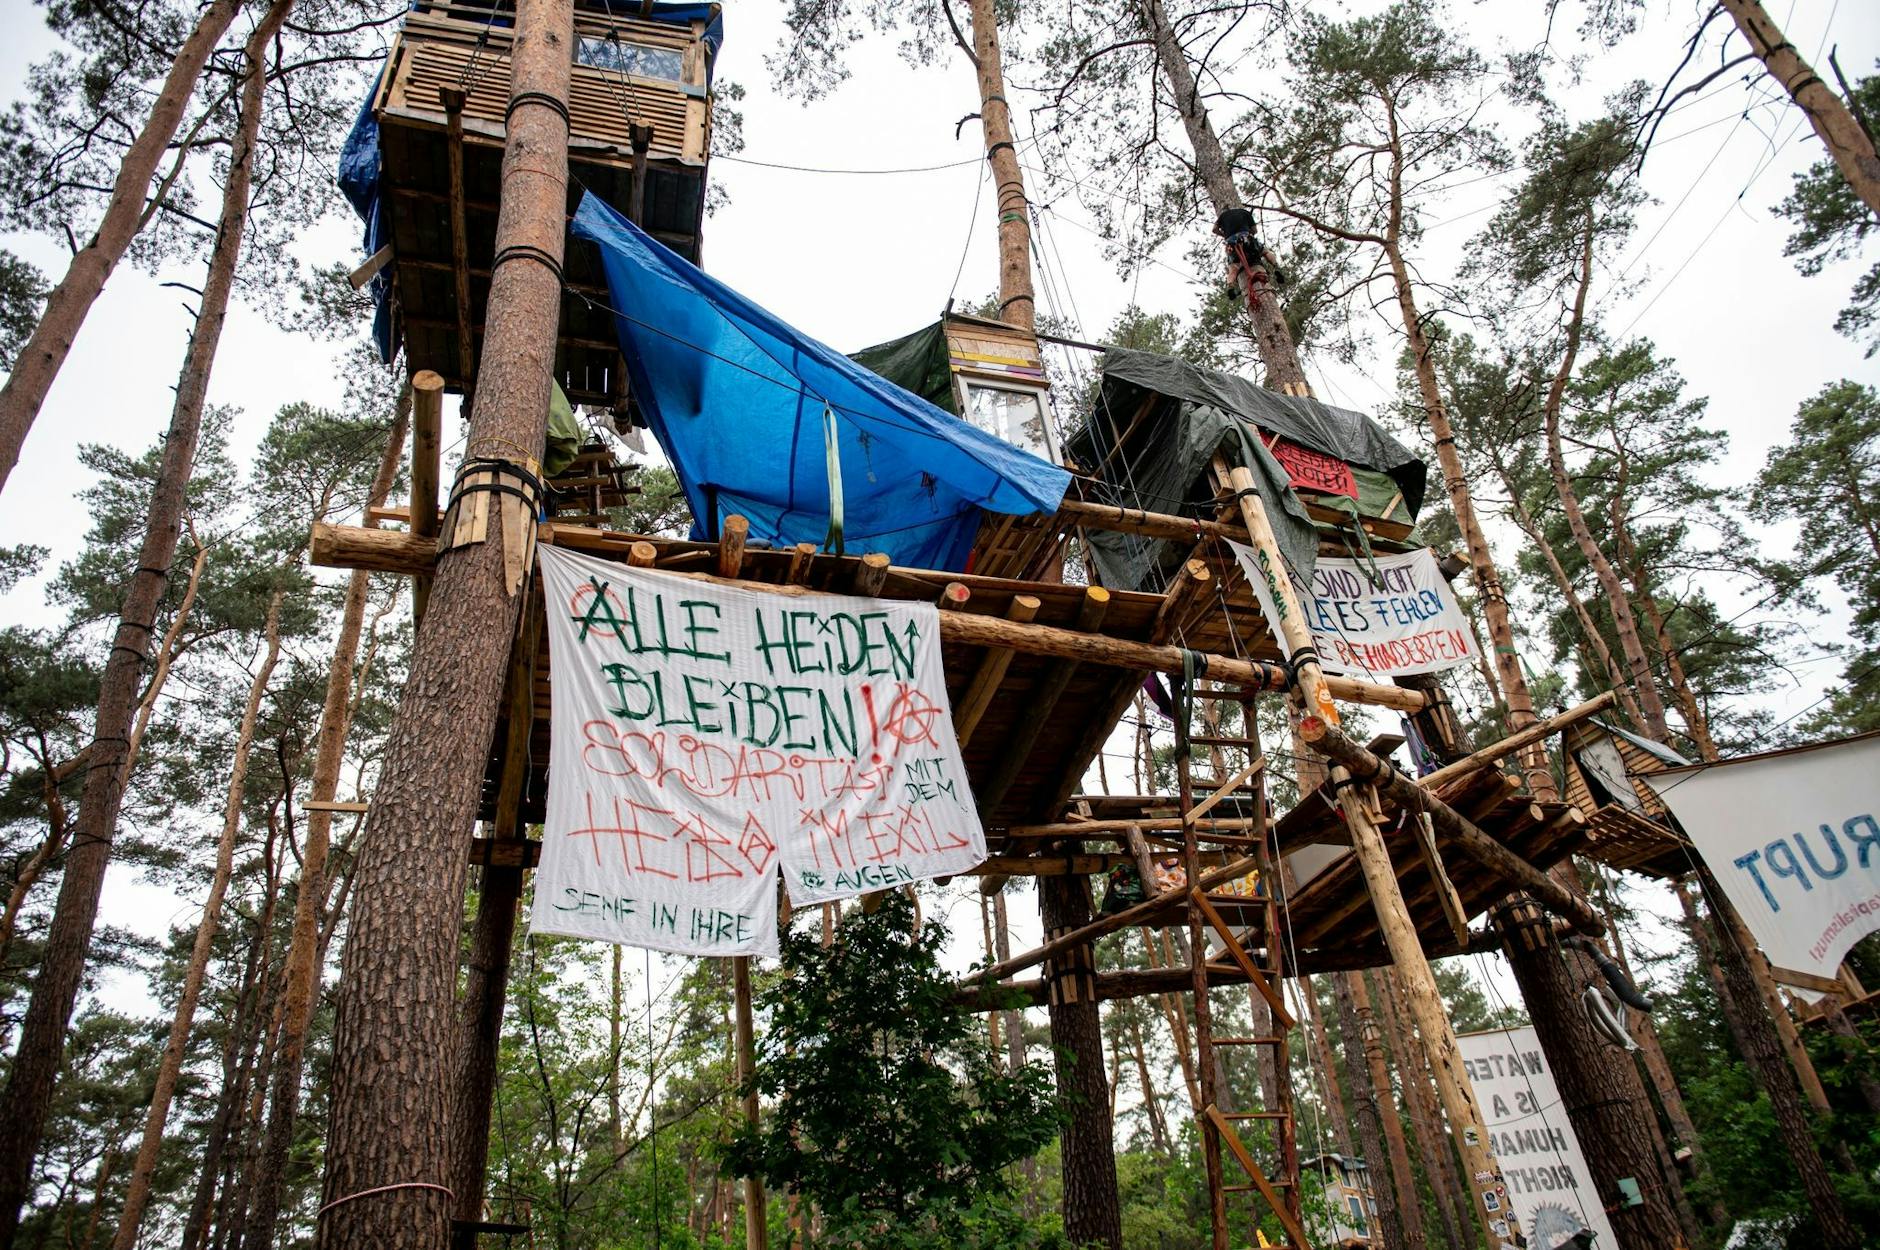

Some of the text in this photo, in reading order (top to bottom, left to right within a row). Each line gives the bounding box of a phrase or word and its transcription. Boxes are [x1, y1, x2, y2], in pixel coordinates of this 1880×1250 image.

[1313, 568, 1362, 600] SIND
[570, 575, 731, 665] ALLE
[1334, 600, 1370, 632] ES
[1370, 587, 1444, 628] FEHLEN
[1334, 628, 1468, 672] BEHINDERTEN
[904, 757, 948, 781] MIT
[904, 778, 959, 804] DEM
[552, 887, 755, 945] SENF IN IHRE
